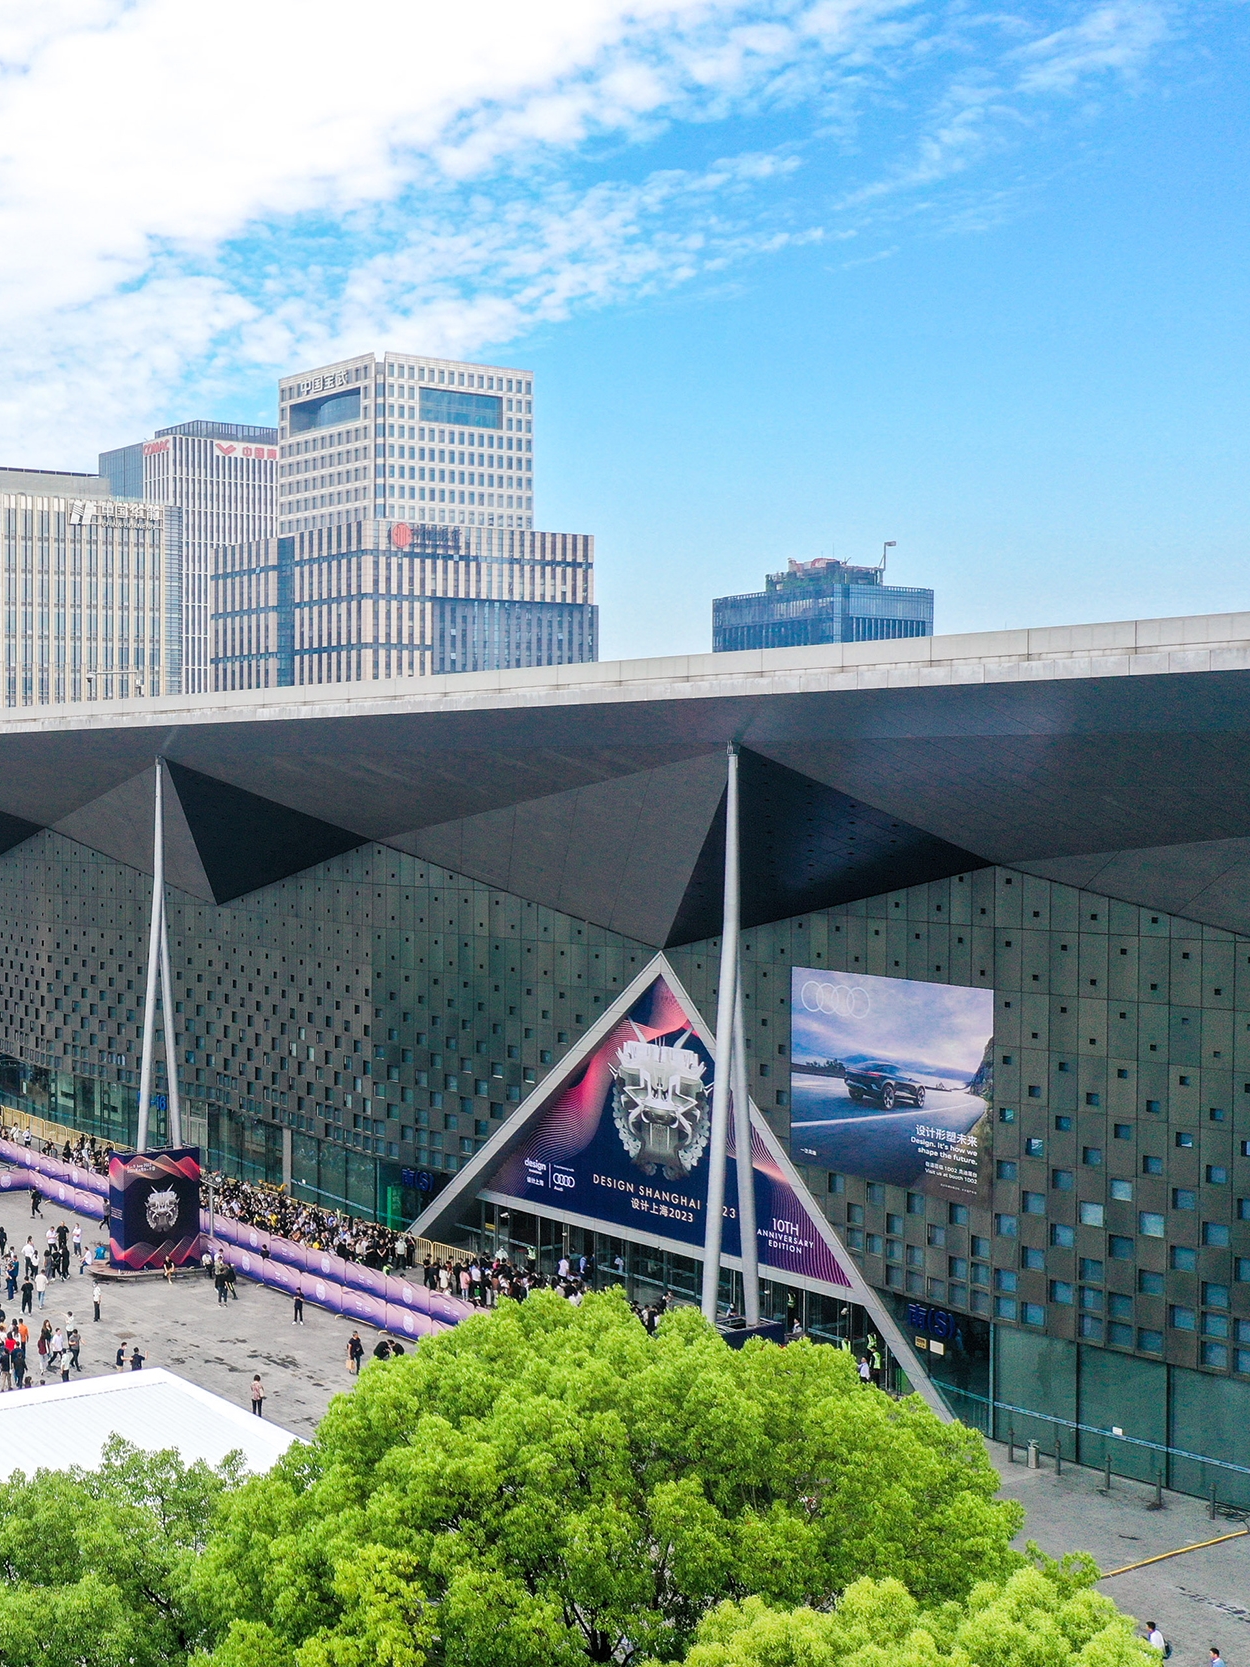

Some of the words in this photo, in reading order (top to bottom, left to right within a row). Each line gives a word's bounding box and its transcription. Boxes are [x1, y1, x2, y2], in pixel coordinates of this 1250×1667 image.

[301, 370, 348, 396] 中国宝武
[143, 438, 170, 456] COMAC
[102, 501, 159, 520] 中国华能
[915, 1124, 978, 1147] 设计形塑未来
[910, 1136, 936, 1148] Design.
[950, 1145, 966, 1154] how
[966, 1149, 978, 1157] we
[918, 1147, 939, 1157] shape
[939, 1152, 952, 1160] the
[953, 1154, 978, 1165] future.
[524, 1157, 546, 1171] design
[944, 1166, 957, 1174] 1002
[924, 1167, 936, 1175] Visit
[964, 1177, 978, 1185] 1002
[593, 1174, 634, 1193] DESIGN
[638, 1185, 701, 1210] SHANGHAI
[630, 1197, 694, 1223] 设计上海2023
[772, 1217, 799, 1236] 10TH
[756, 1228, 814, 1248] ANNIVERSARY
[768, 1239, 802, 1254] EDITION
[907, 1303, 956, 1339] 南(S)
